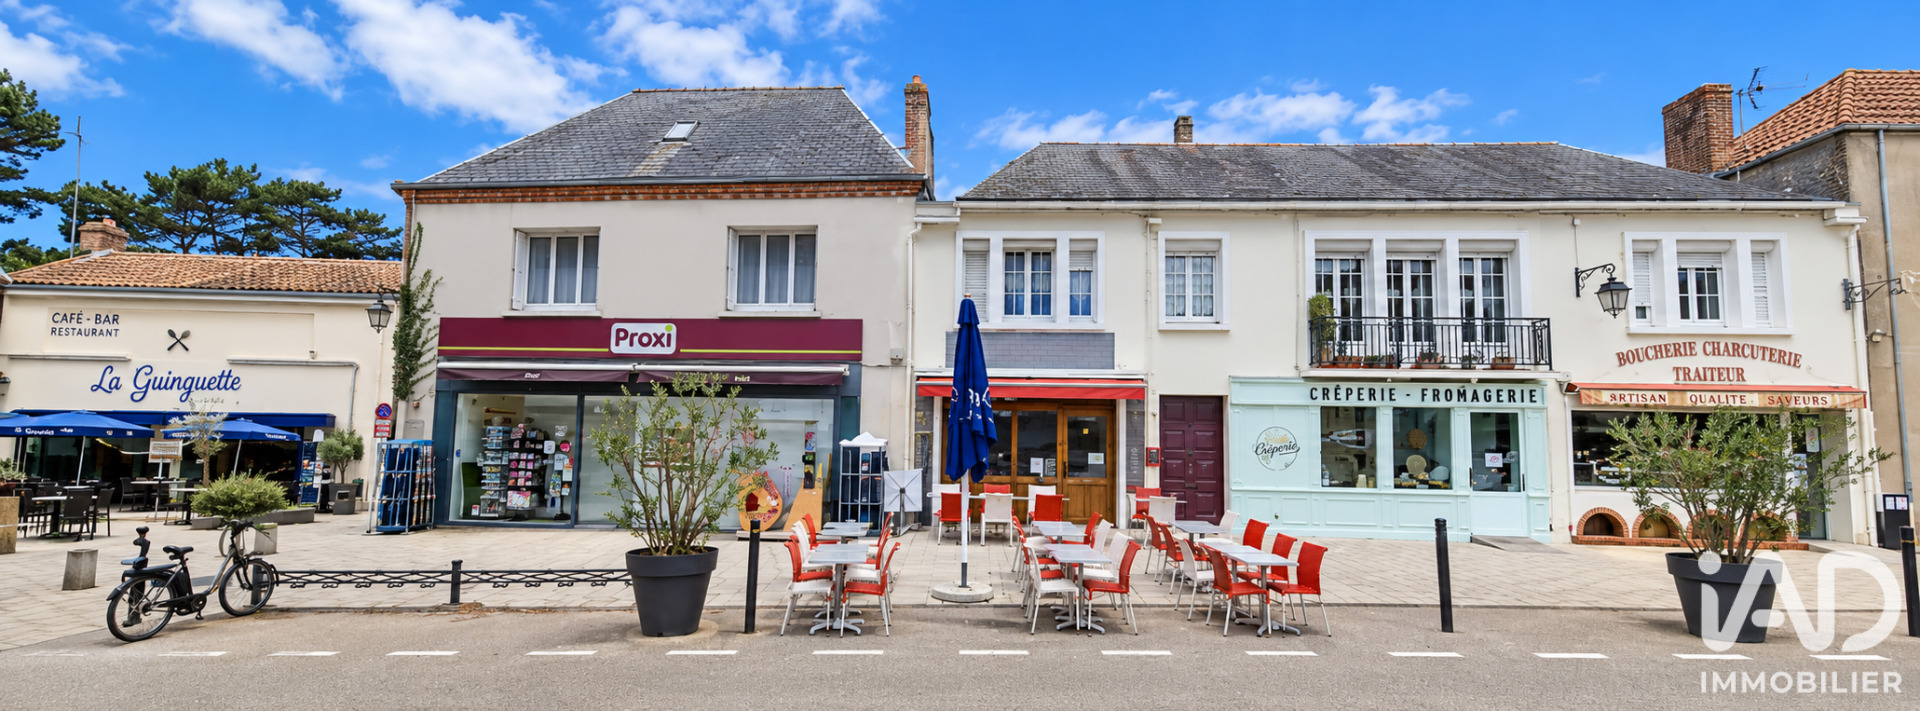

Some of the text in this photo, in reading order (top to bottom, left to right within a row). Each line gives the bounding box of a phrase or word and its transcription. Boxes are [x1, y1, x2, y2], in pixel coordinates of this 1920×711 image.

[52, 310, 83, 324] CAFÉ
[94, 313, 120, 325] BAR
[50, 327, 120, 337] RESTAURANT
[615, 324, 672, 348] Proxi
[1616, 340, 1803, 369] BOUCHERIE CHARCUTERIE
[1672, 366, 1747, 382] TRAITEUR
[90, 364, 242, 403] La Guinguette
[1309, 384, 1397, 401] CRÊPERIE
[1420, 387, 1538, 403] FROMAGERIE
[1609, 393, 1829, 406] ARTISAN QUALITE SAVEURS
